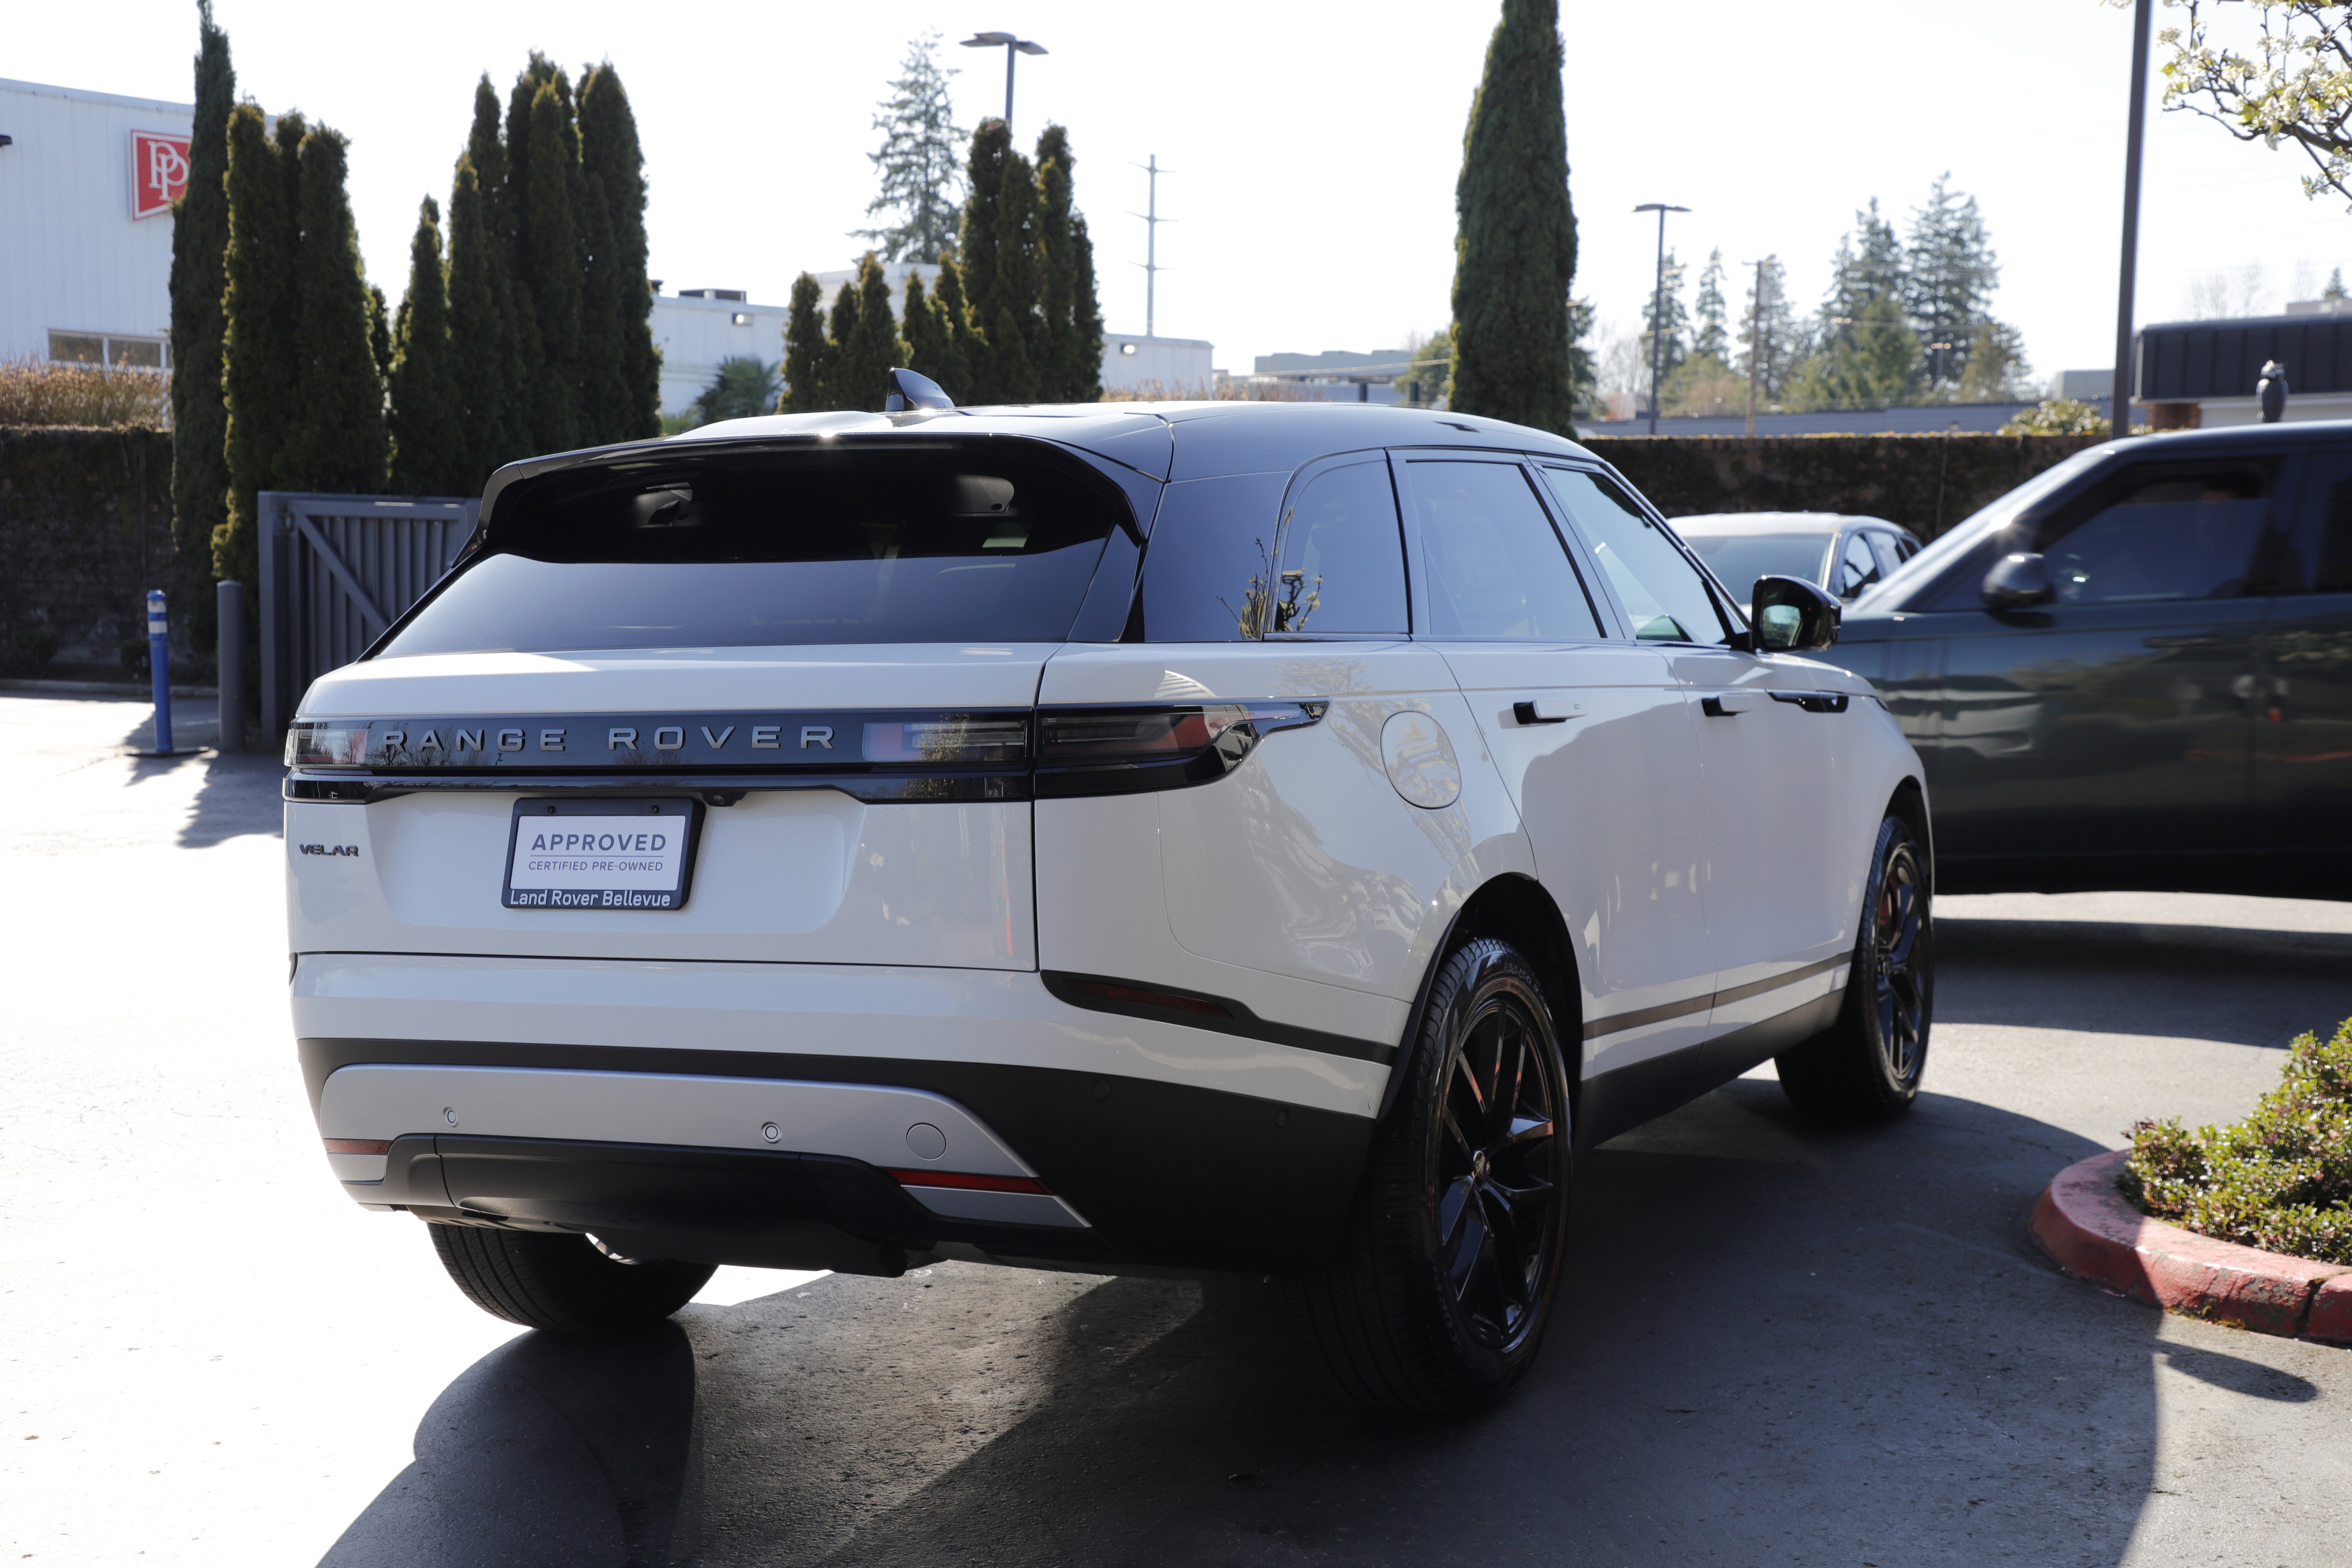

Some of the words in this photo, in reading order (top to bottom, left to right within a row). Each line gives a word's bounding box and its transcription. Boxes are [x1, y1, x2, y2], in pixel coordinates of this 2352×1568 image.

[382, 729, 567, 752] RANGE
[608, 726, 835, 750] ROVER
[299, 844, 359, 857] VELAR
[531, 834, 666, 851] APPROVED
[528, 861, 588, 871] CERTIFIED
[592, 862, 663, 871] PRE-OWNED
[510, 889, 548, 905] Land
[551, 890, 599, 906] Rover
[602, 890, 670, 907] Bellevue
[1431, 1254, 1464, 1354] SCORP
